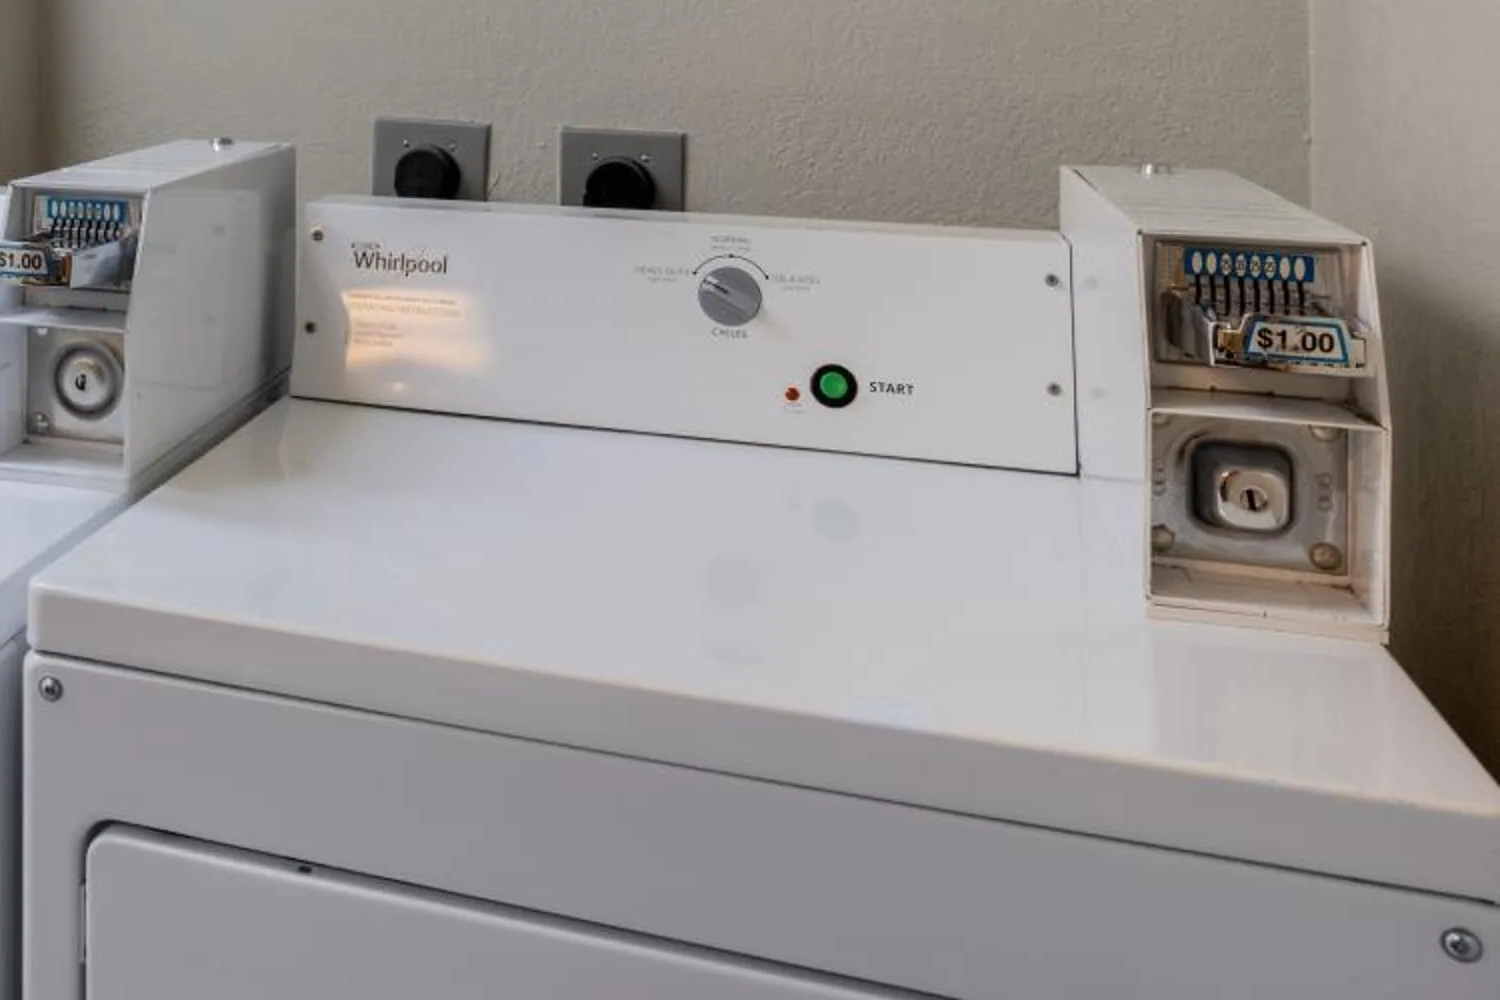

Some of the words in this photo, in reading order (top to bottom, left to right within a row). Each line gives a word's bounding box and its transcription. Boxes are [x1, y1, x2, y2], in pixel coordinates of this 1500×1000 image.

[354, 250, 447, 277] Whirlpool
[1256, 327, 1335, 354] $1.00
[869, 381, 915, 396] START
